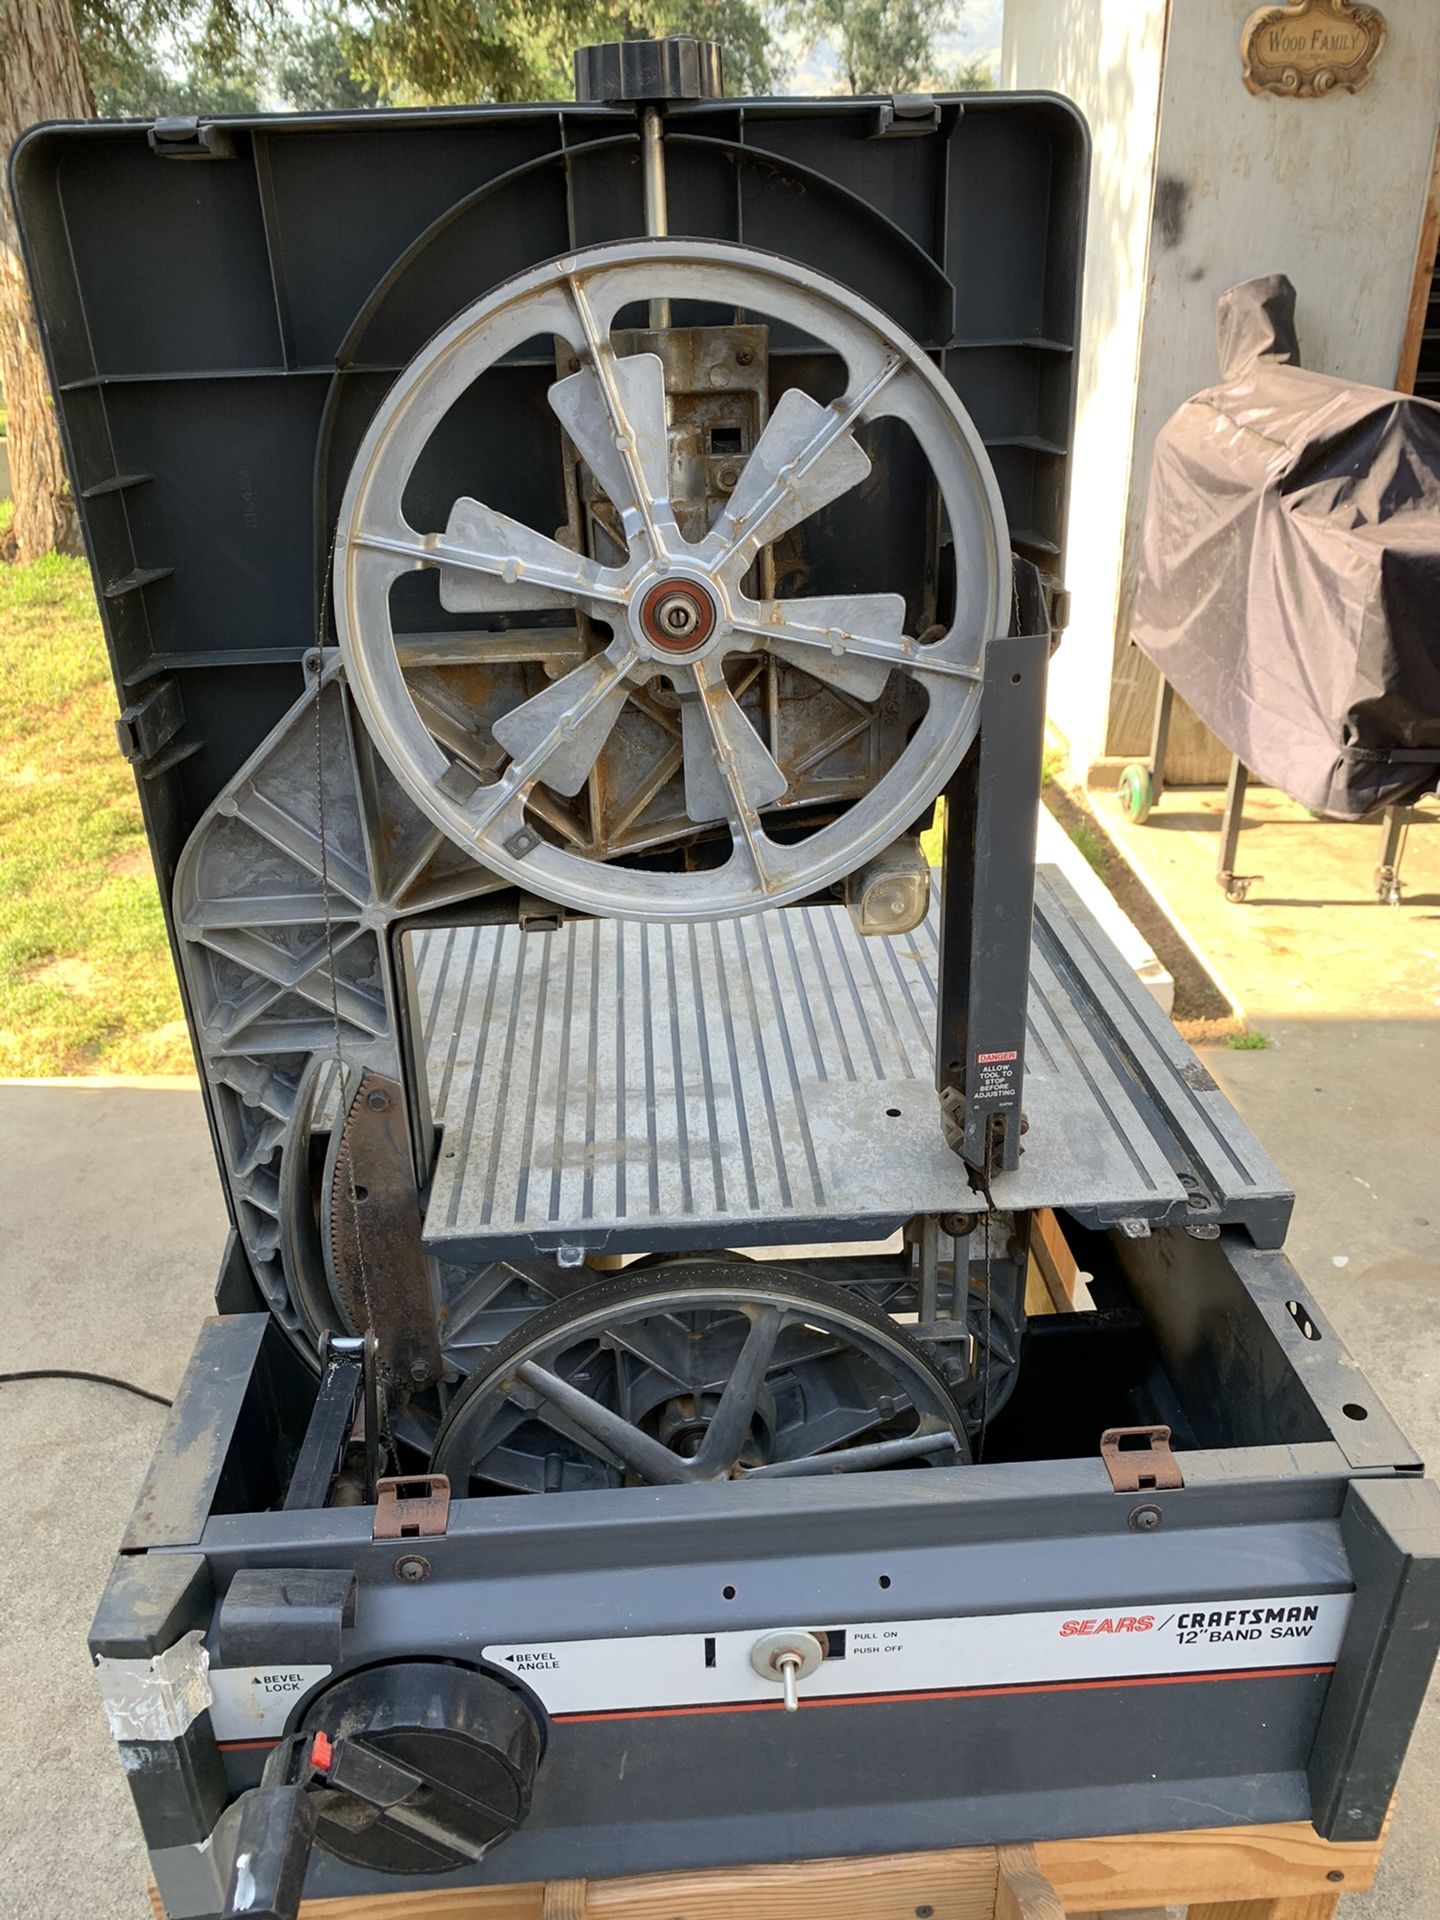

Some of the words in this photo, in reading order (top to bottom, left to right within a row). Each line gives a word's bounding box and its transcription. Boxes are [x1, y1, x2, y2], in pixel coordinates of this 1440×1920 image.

[981, 1053, 1015, 1061] DANGER
[980, 1083, 1009, 1092] BEFORE
[974, 1089, 1015, 1099] ADJUSTING
[1059, 1615, 1156, 1637] SEARS
[1177, 1606, 1319, 1629] CRAFTSMAN
[854, 1632, 878, 1640] PULL
[883, 1631, 898, 1639] ON
[1208, 1628, 1262, 1643] BAND
[1270, 1625, 1313, 1640] SAW
[853, 1646, 880, 1655] PUSH
[884, 1645, 904, 1653] OFF
[516, 1653, 556, 1663] BEVEL
[518, 1661, 560, 1671] ANGLE
[263, 1674, 304, 1684] BEVEL
[265, 1683, 300, 1692] LOCK
